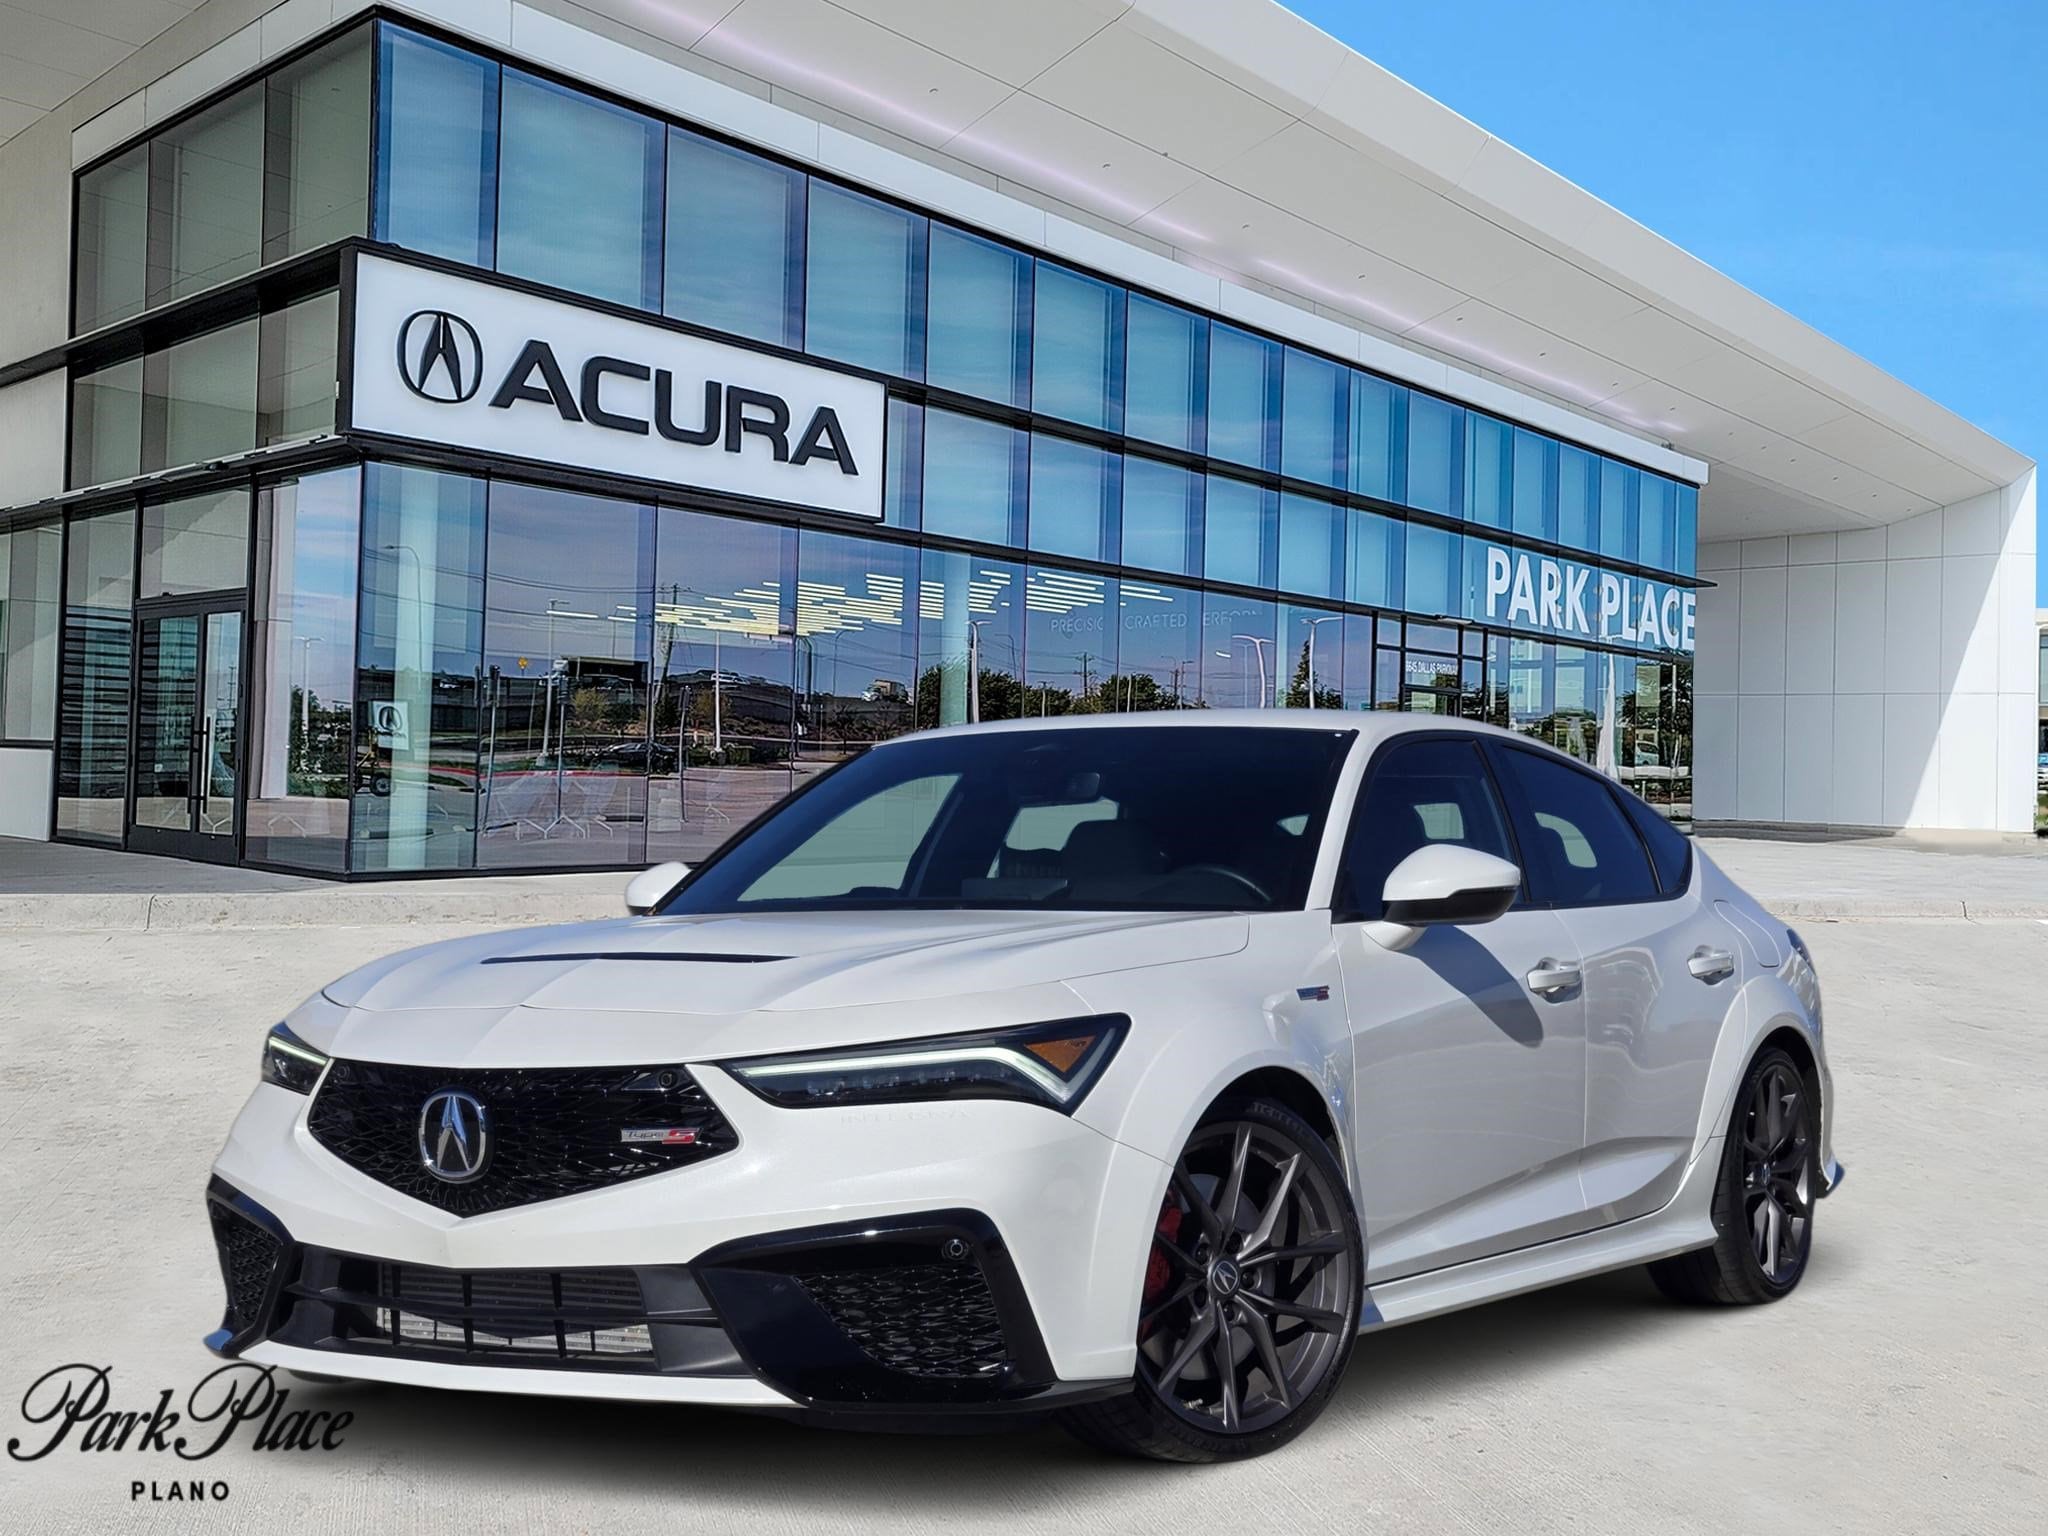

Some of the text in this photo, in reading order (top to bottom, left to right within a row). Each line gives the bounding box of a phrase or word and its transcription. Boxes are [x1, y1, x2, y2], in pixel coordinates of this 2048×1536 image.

[488, 339, 859, 475] ACURA
[1124, 612, 1188, 630] CRAFTED
[1486, 546, 1696, 650] PARK PLACE
